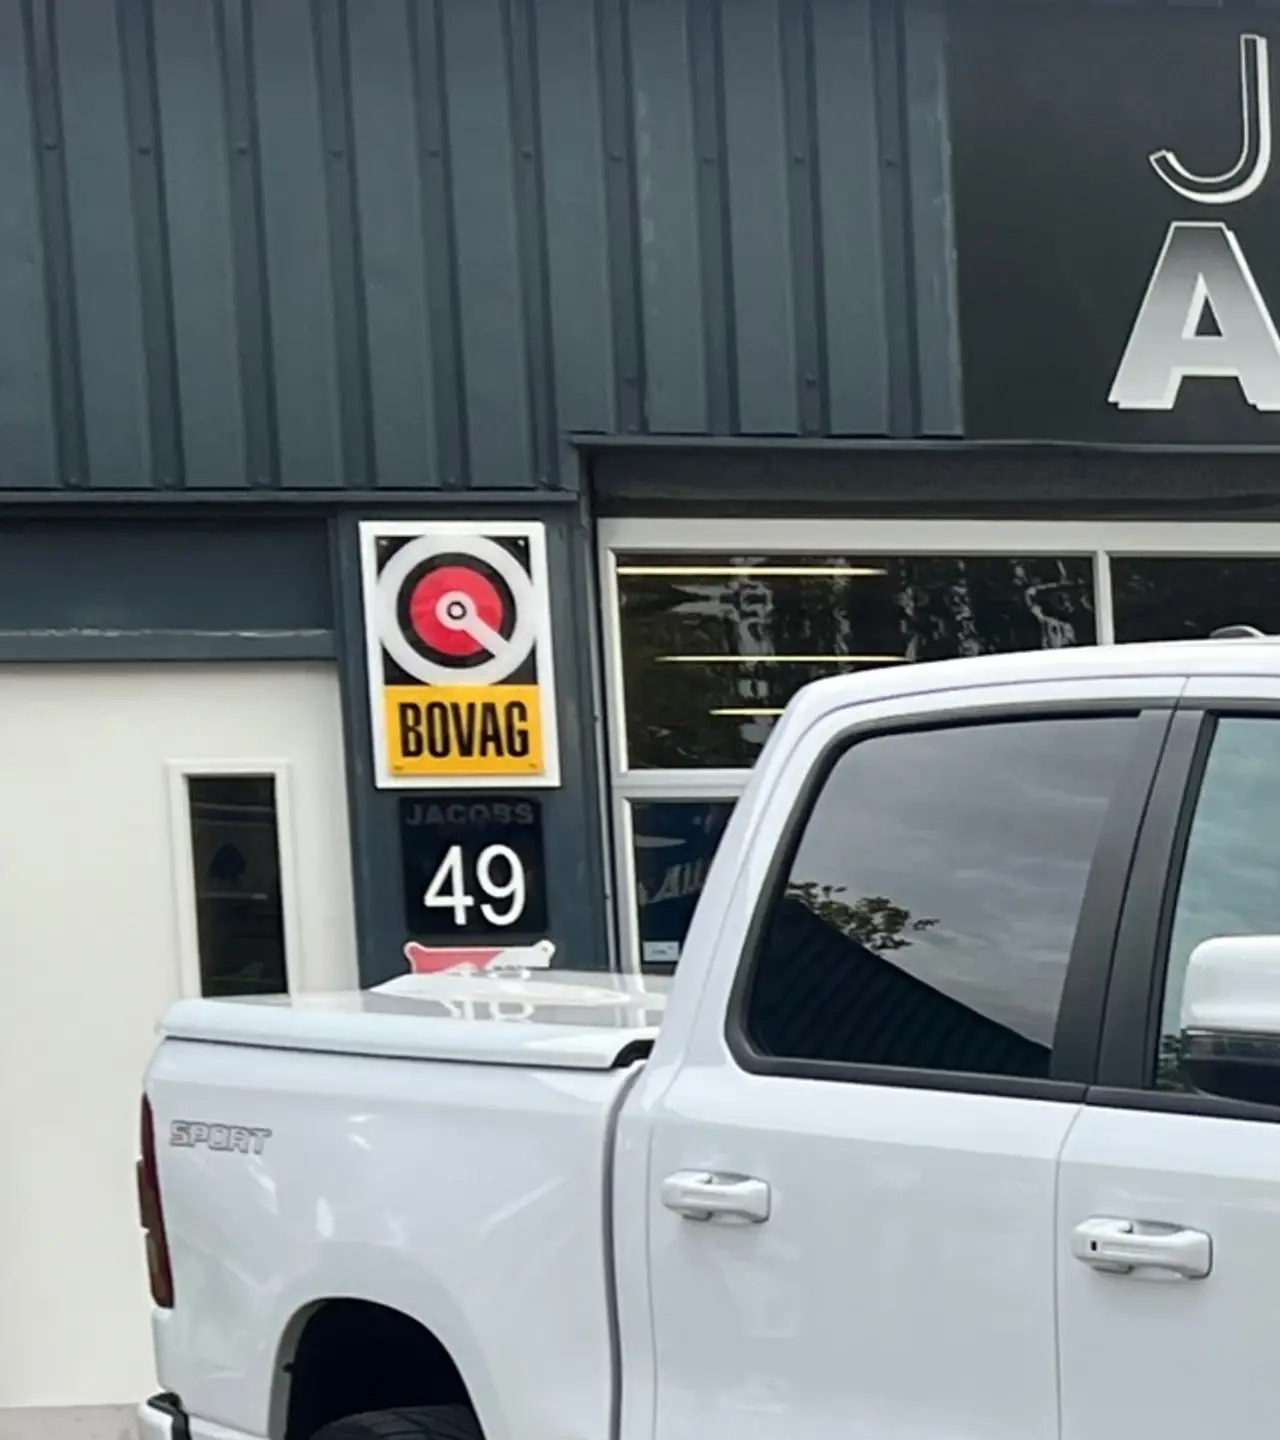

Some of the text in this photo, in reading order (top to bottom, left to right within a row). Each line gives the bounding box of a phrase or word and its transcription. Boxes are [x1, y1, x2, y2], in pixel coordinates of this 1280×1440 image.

[398, 700, 530, 759] BOVAG
[405, 802, 534, 826] JACOBS
[424, 844, 526, 926] 49
[169, 1119, 273, 1156] SPORT
